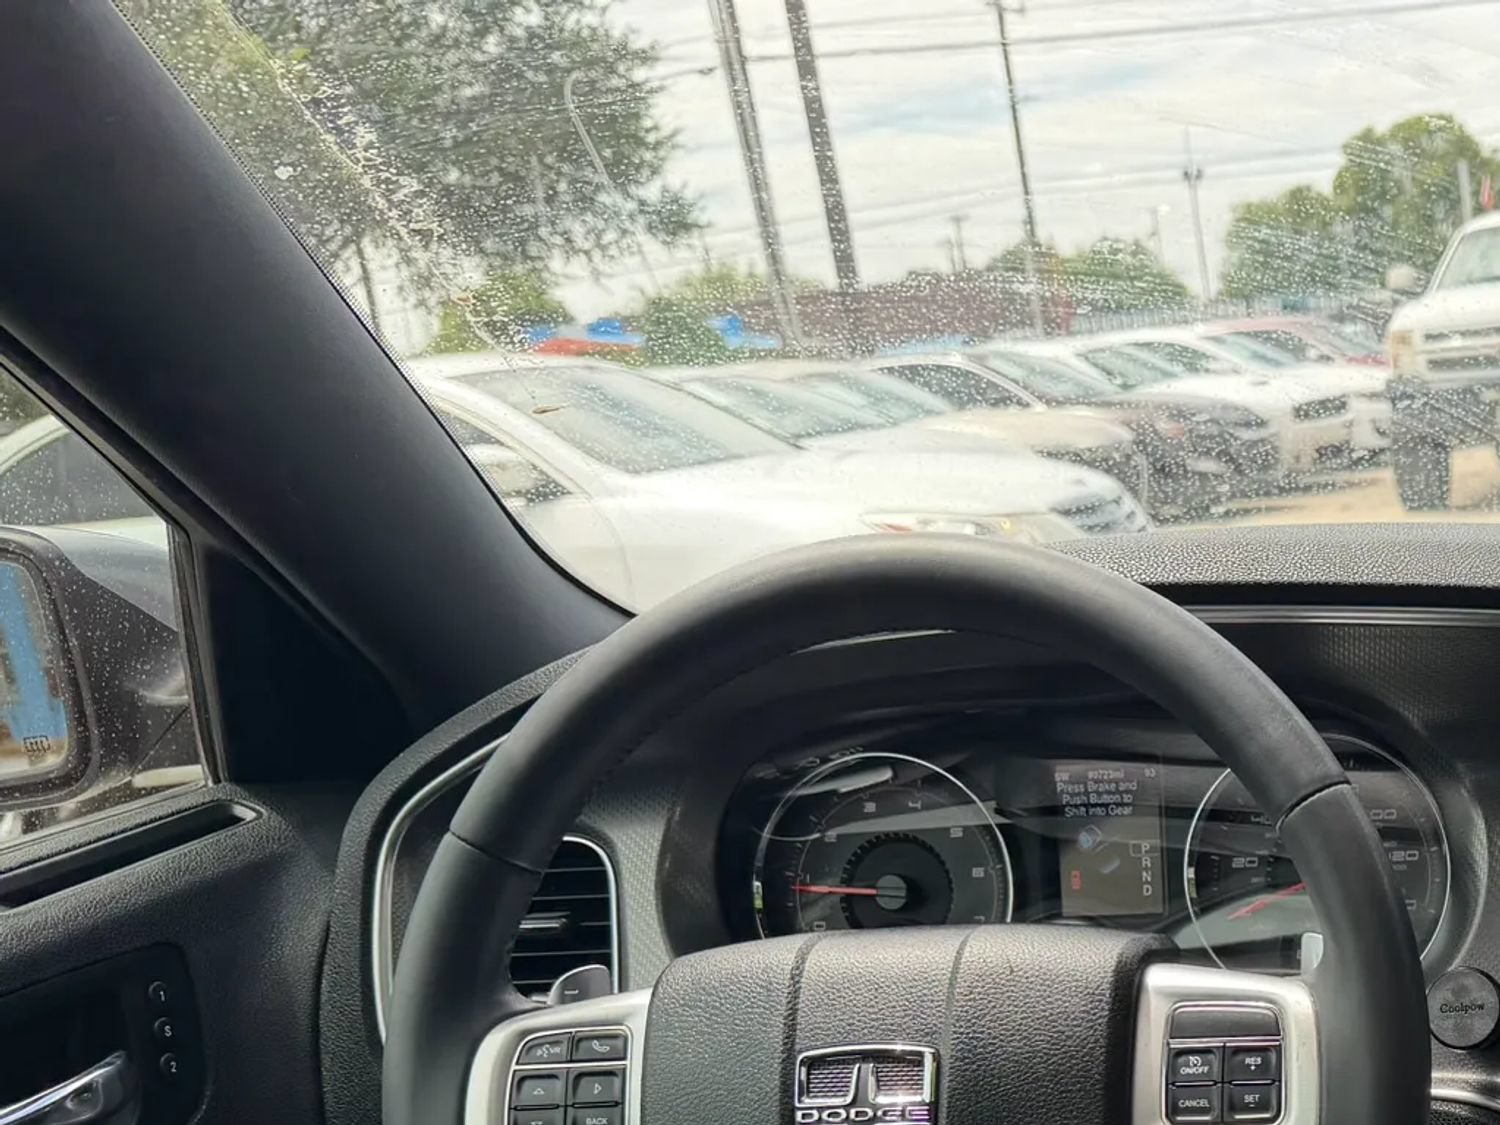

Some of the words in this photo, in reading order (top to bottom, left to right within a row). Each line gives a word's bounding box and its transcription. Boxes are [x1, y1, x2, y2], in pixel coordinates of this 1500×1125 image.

[1056, 781, 1085, 793] Press
[1087, 780, 1117, 793] Brake
[1118, 779, 1137, 791] and
[1062, 793, 1088, 805] Push
[1089, 792, 1121, 804] Button
[1122, 793, 1133, 803] to
[1064, 806, 1086, 818] Shift
[1088, 806, 1106, 816] into
[1107, 804, 1133, 816] Gear
[1141, 842, 1150, 855] P
[1142, 856, 1151, 868] R
[1142, 870, 1151, 882] N
[1143, 885, 1152, 896] D
[160, 990, 166, 1001] 1
[1440, 1001, 1485, 1015] Coolpow
[164, 1025, 172, 1037] S
[170, 1061, 177, 1072] 2
[1244, 1056, 1262, 1065] RES
[1179, 1065, 1210, 1075] ON/OFF
[1178, 1098, 1211, 1108] CANCEL
[1244, 1094, 1261, 1103] SET
[797, 1105, 930, 1123] DODGE
[585, 1117, 609, 1125] BACK
